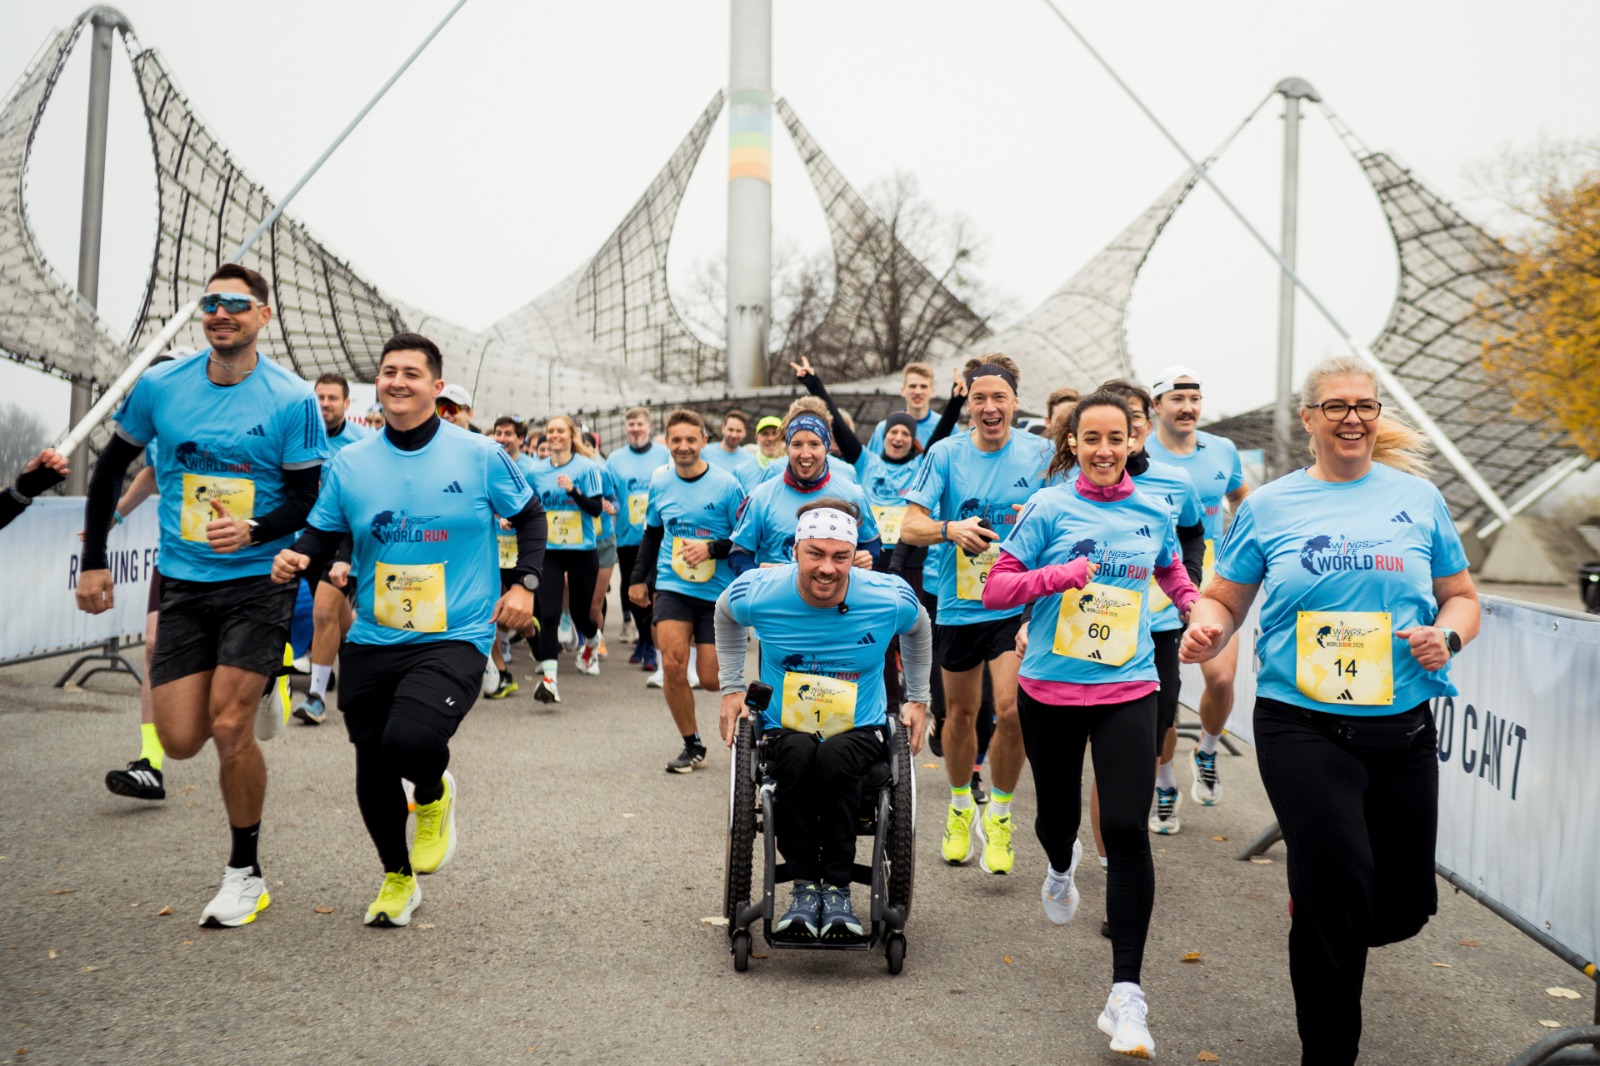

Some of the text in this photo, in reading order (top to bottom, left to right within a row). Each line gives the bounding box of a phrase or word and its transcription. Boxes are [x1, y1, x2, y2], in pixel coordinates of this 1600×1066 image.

[188, 457, 252, 474] WORLD RUN
[1004, 514, 1018, 525] RU
[384, 529, 448, 543] WORLD RUN
[1330, 540, 1369, 549] WINGS
[1095, 548, 1127, 558] WINGS
[1337, 548, 1358, 556] LIFE
[68, 549, 138, 590] RING
[1317, 554, 1404, 573] WORLD RUN
[1093, 562, 1149, 580] ORLD RUN
[980, 572, 987, 584] 6
[403, 599, 412, 612] 3
[1088, 623, 1110, 640] 60
[1333, 628, 1361, 636] WINGS
[1334, 658, 1358, 677] 14
[837, 671, 860, 681] RUN
[814, 710, 820, 722] 1
[1462, 704, 1526, 800] CAN'T
